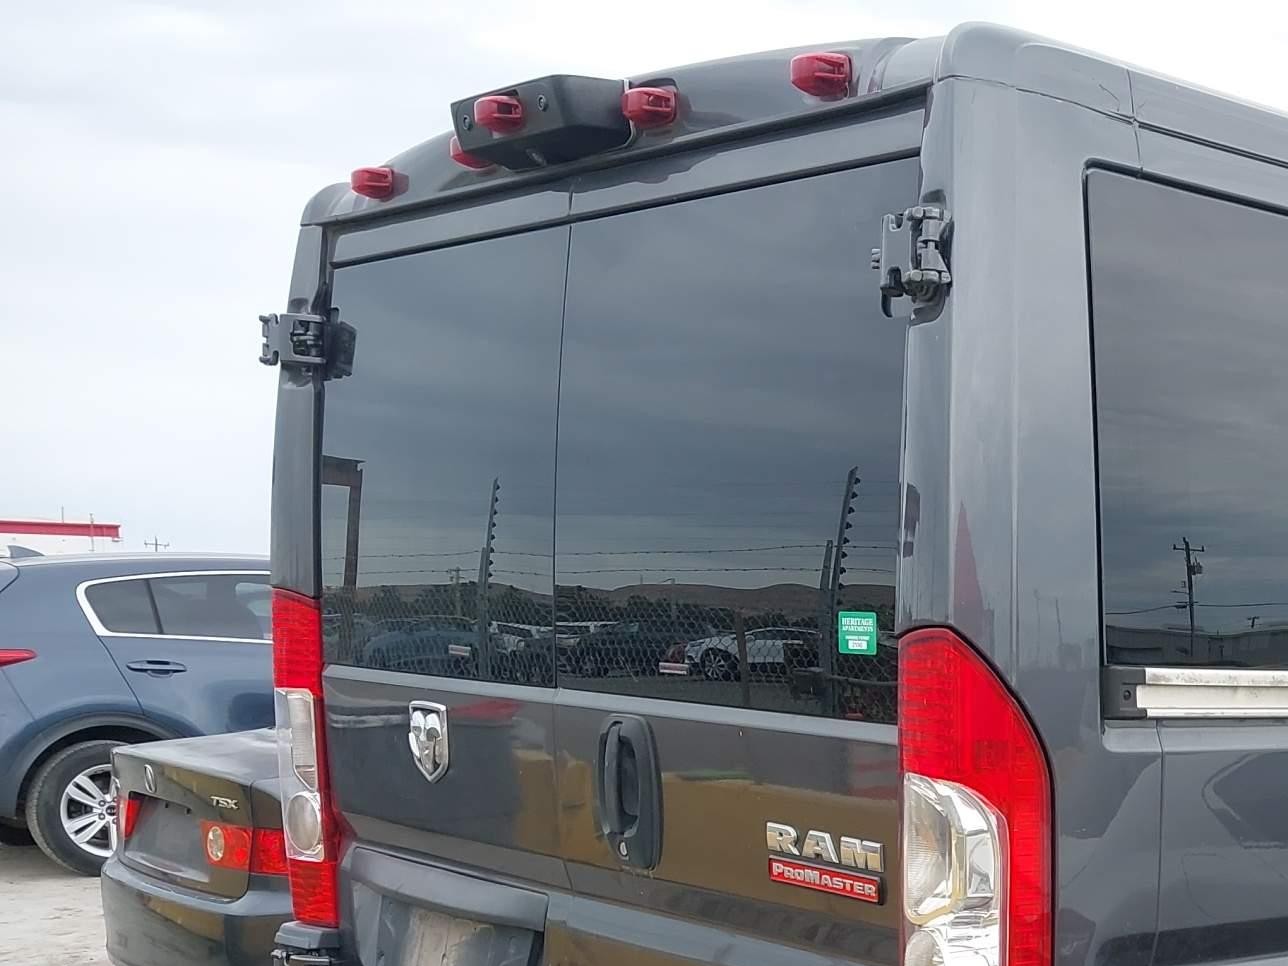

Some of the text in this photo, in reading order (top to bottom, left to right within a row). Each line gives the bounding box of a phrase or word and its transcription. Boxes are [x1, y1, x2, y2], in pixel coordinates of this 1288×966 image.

[841, 617, 874, 626] HERITAGE
[210, 796, 239, 809] TSX
[766, 822, 884, 872] RAM
